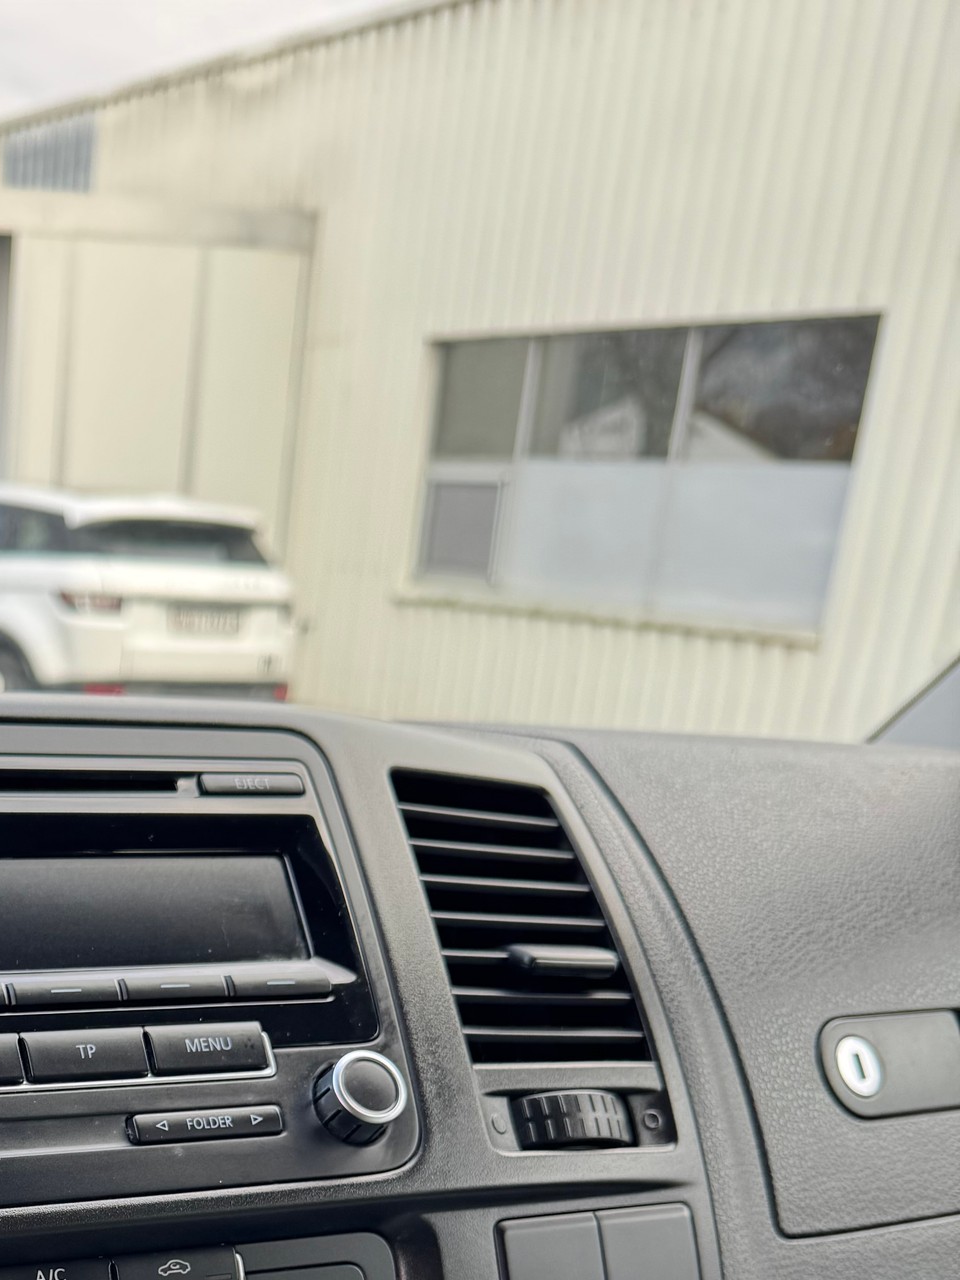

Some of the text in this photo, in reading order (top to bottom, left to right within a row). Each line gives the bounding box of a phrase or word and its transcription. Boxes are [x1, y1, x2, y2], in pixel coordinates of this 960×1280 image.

[234, 778, 270, 791] EJECT
[76, 1044, 96, 1059] TP
[185, 1037, 233, 1053] MENU
[186, 1115, 233, 1131] FOLDER
